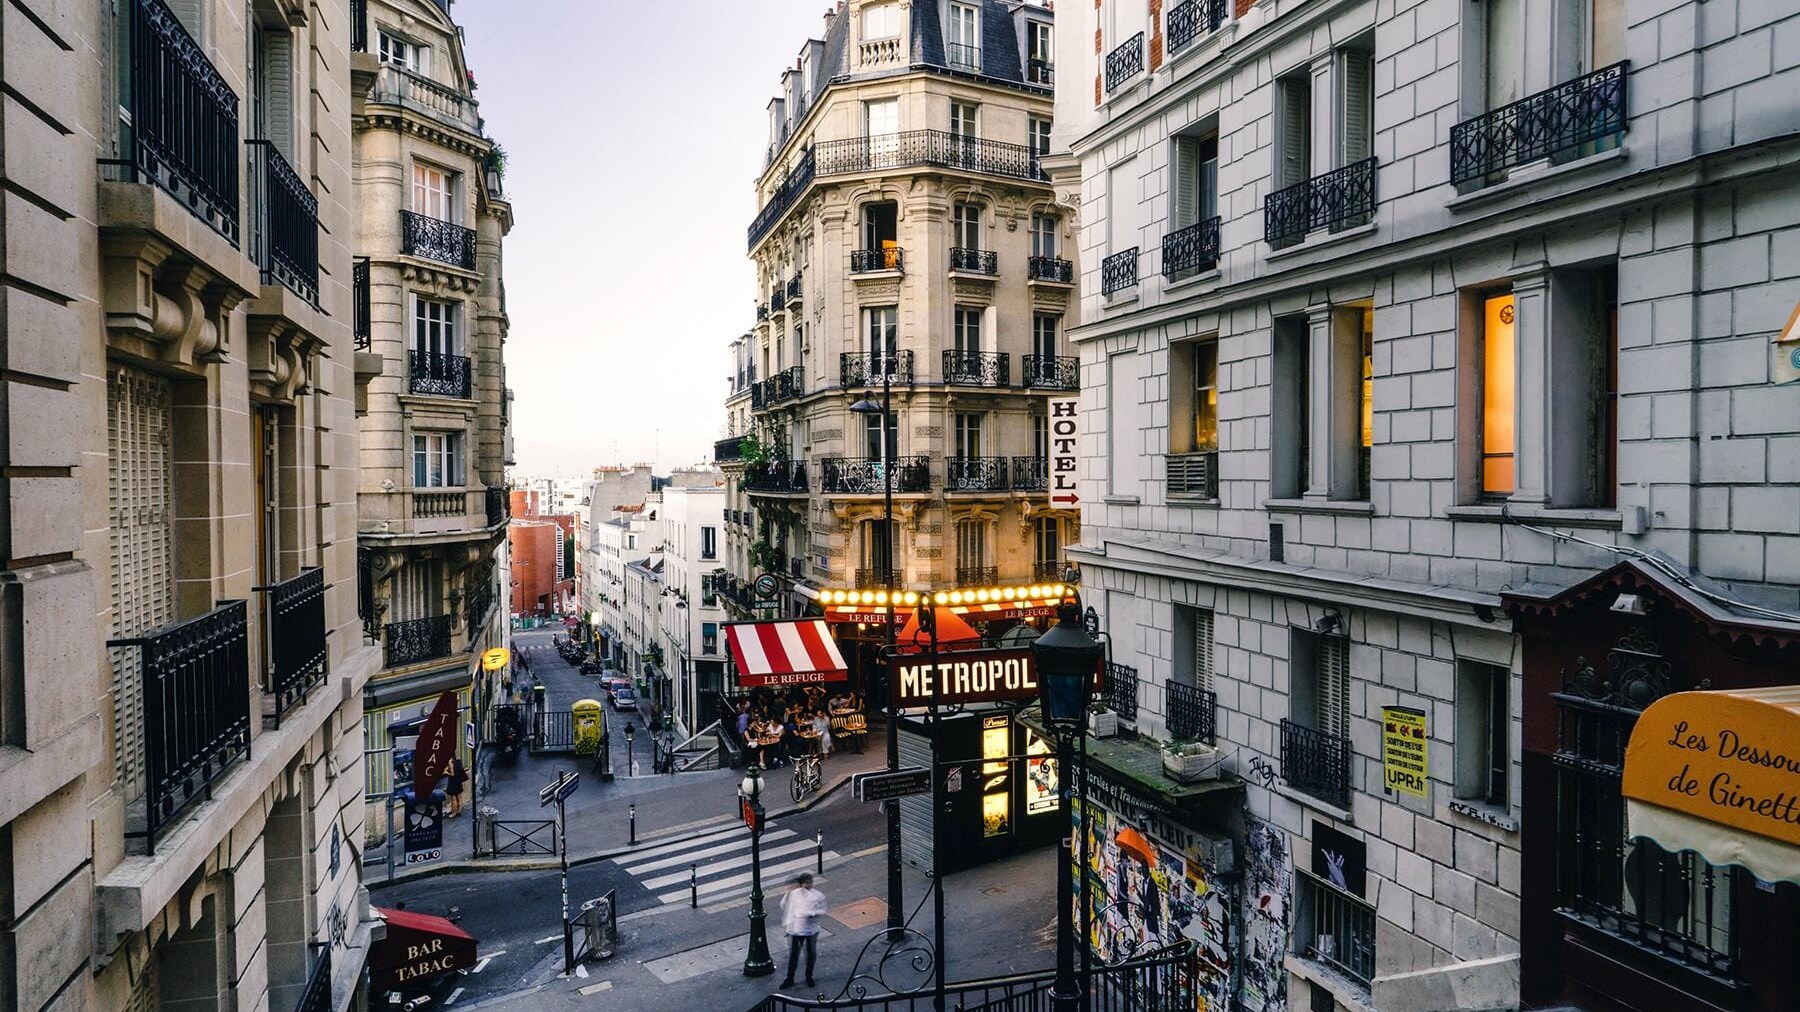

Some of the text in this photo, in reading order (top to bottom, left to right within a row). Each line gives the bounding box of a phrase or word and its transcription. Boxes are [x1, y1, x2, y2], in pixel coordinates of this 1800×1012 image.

[1052, 402, 1077, 490] HOTEL
[849, 614, 903, 624] LE REFUE
[764, 673, 825, 685] LE REFUGE
[900, 657, 1098, 698] METROPOL
[425, 713, 449, 777] TABAC
[1668, 721, 1710, 752] Les
[1668, 764, 1800, 826] de Ginett
[408, 849, 440, 863] LOTO
[407, 939, 443, 960] BAR
[395, 955, 454, 981] TABAC
